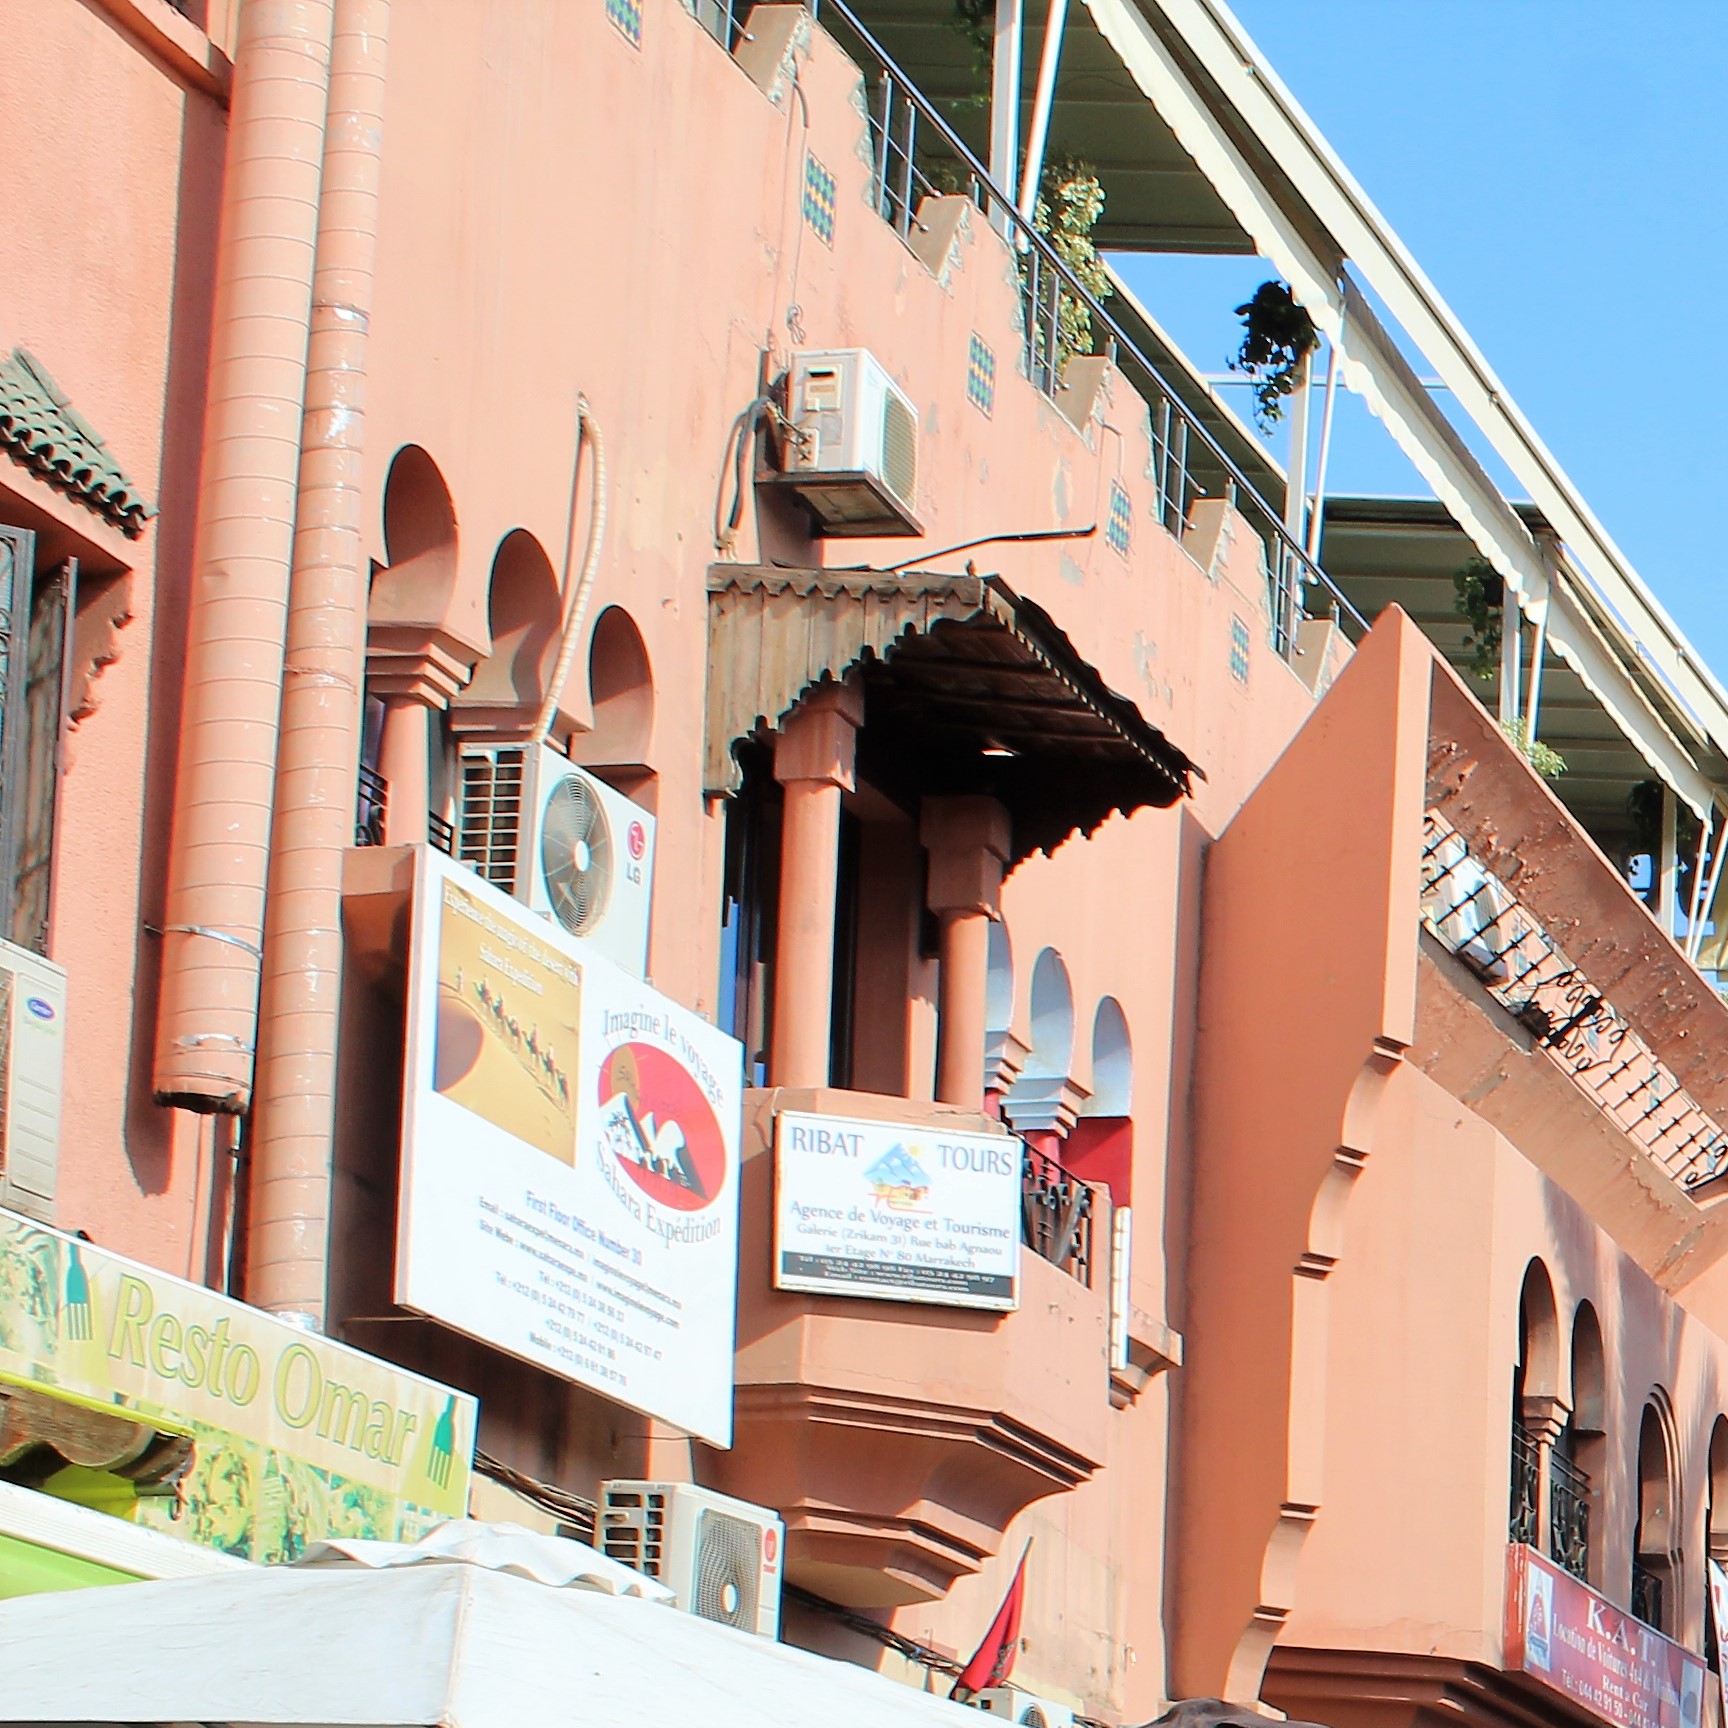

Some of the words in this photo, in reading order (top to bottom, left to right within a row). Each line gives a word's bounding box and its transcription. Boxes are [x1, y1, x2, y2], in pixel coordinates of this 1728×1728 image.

[626, 862, 641, 885] LG
[604, 1003, 660, 1040] Imagine
[664, 1014, 677, 1044] le
[791, 1126, 866, 1160] RIBAT
[937, 1143, 1013, 1178] TOURS
[645, 1201, 721, 1250] Expédition
[790, 1201, 845, 1222] Agence
[848, 1205, 866, 1223] de
[870, 1209, 922, 1232] Voyage
[924, 1218, 938, 1231] et
[944, 1217, 1012, 1240] Tourisme
[797, 1222, 838, 1238] Galerie
[910, 1232, 932, 1248] Rue
[935, 1237, 957, 1252] bab
[915, 1251, 977, 1270] Marrakech
[109, 1272, 259, 1408] Resto
[273, 1344, 420, 1470] Omar
[1553, 1613, 1586, 1654] Location
[1602, 1674, 1624, 1700] Rent
